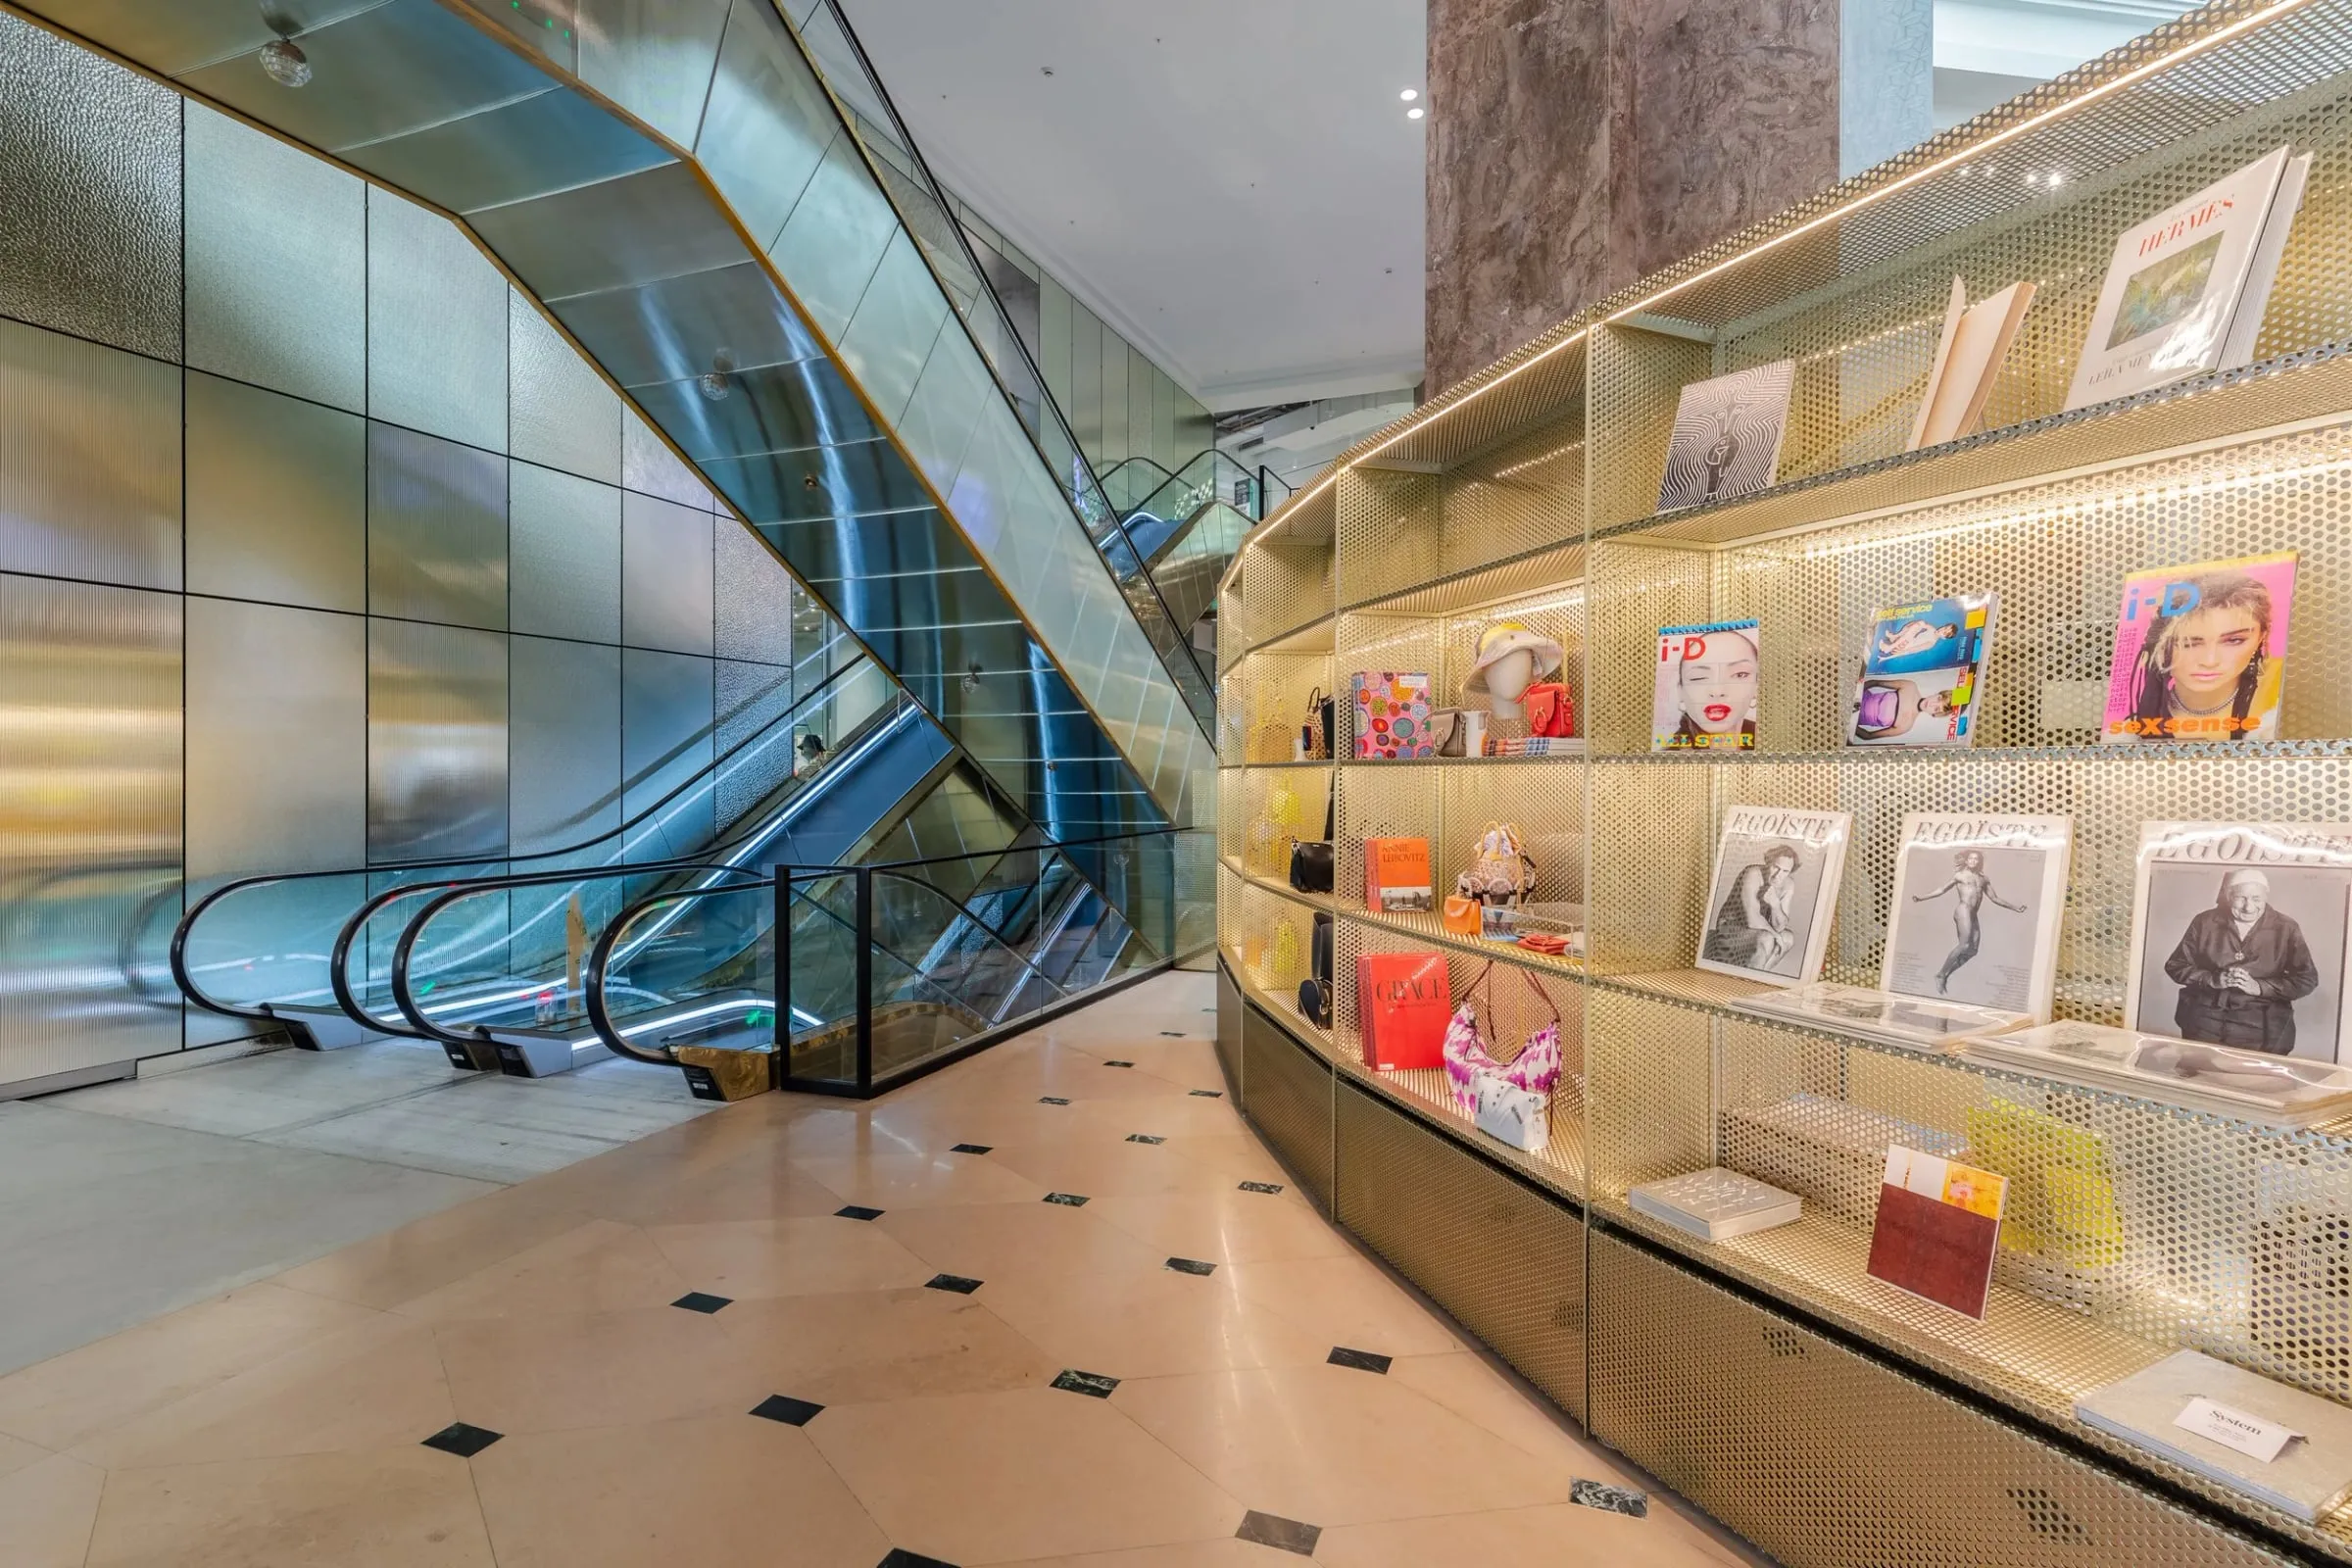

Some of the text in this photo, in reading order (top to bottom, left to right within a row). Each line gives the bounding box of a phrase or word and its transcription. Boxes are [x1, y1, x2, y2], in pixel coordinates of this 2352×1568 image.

[1896, 604, 1933, 617] service
[2127, 580, 2200, 620] i-D
[1661, 636, 1706, 662] i-D
[1376, 979, 1448, 1001] GRACE
[2209, 1408, 2263, 1437] System
